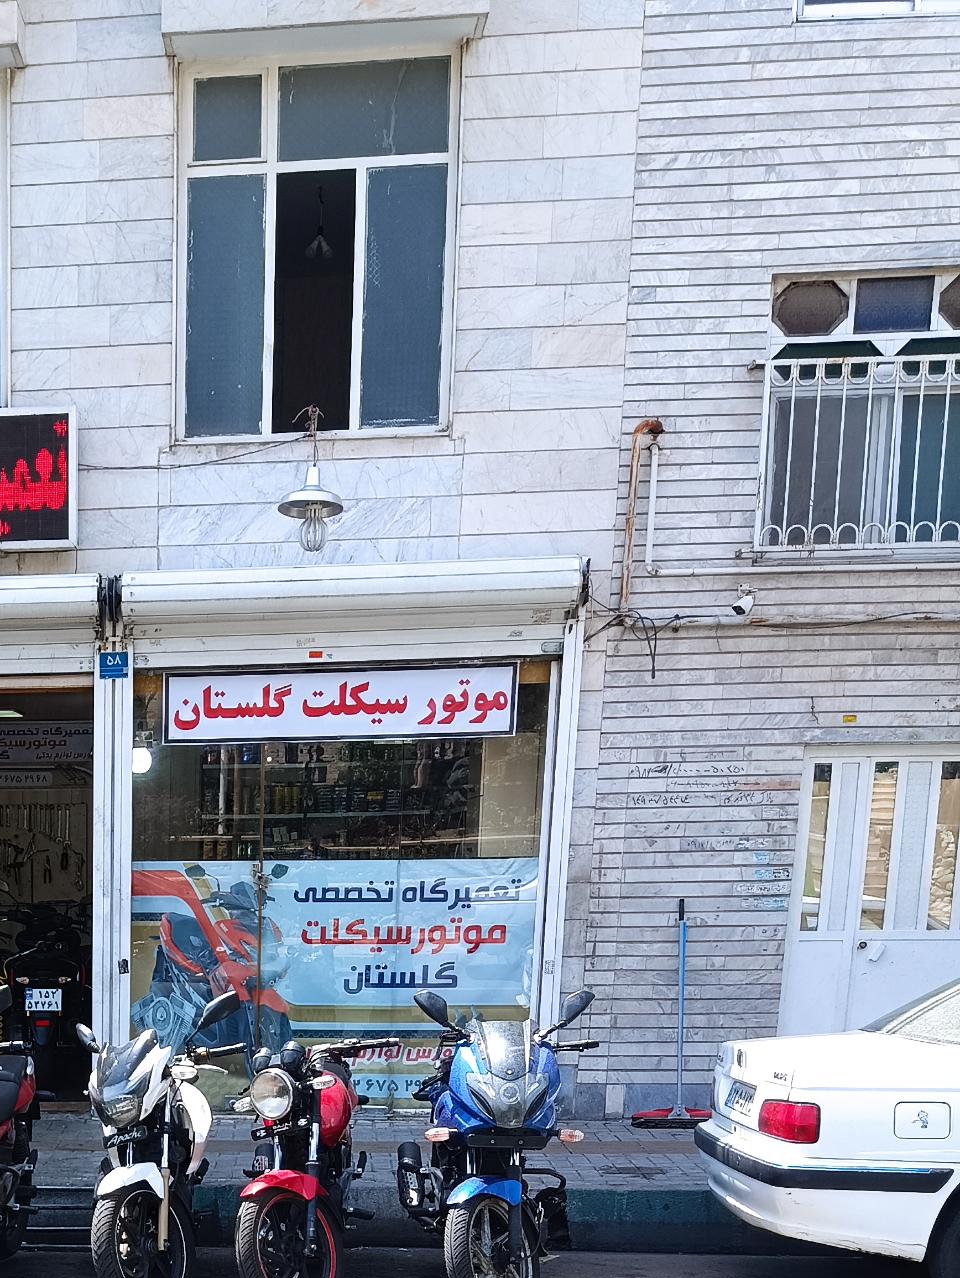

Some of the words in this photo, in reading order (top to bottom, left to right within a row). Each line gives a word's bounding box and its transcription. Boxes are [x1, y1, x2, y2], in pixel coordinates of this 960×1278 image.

[106, 654, 122, 666] ۵۸
[173, 683, 293, 731] گلستان
[302, 681, 408, 725] سیکلت
[417, 678, 510, 726] موتور
[293, 876, 395, 904] تخصصی
[401, 876, 522, 911] تعمیرگاه
[300, 916, 507, 955] موتورسیکلت
[343, 961, 459, 996] گلستان
[366, 1078, 399, 1092] ۶۷۵
